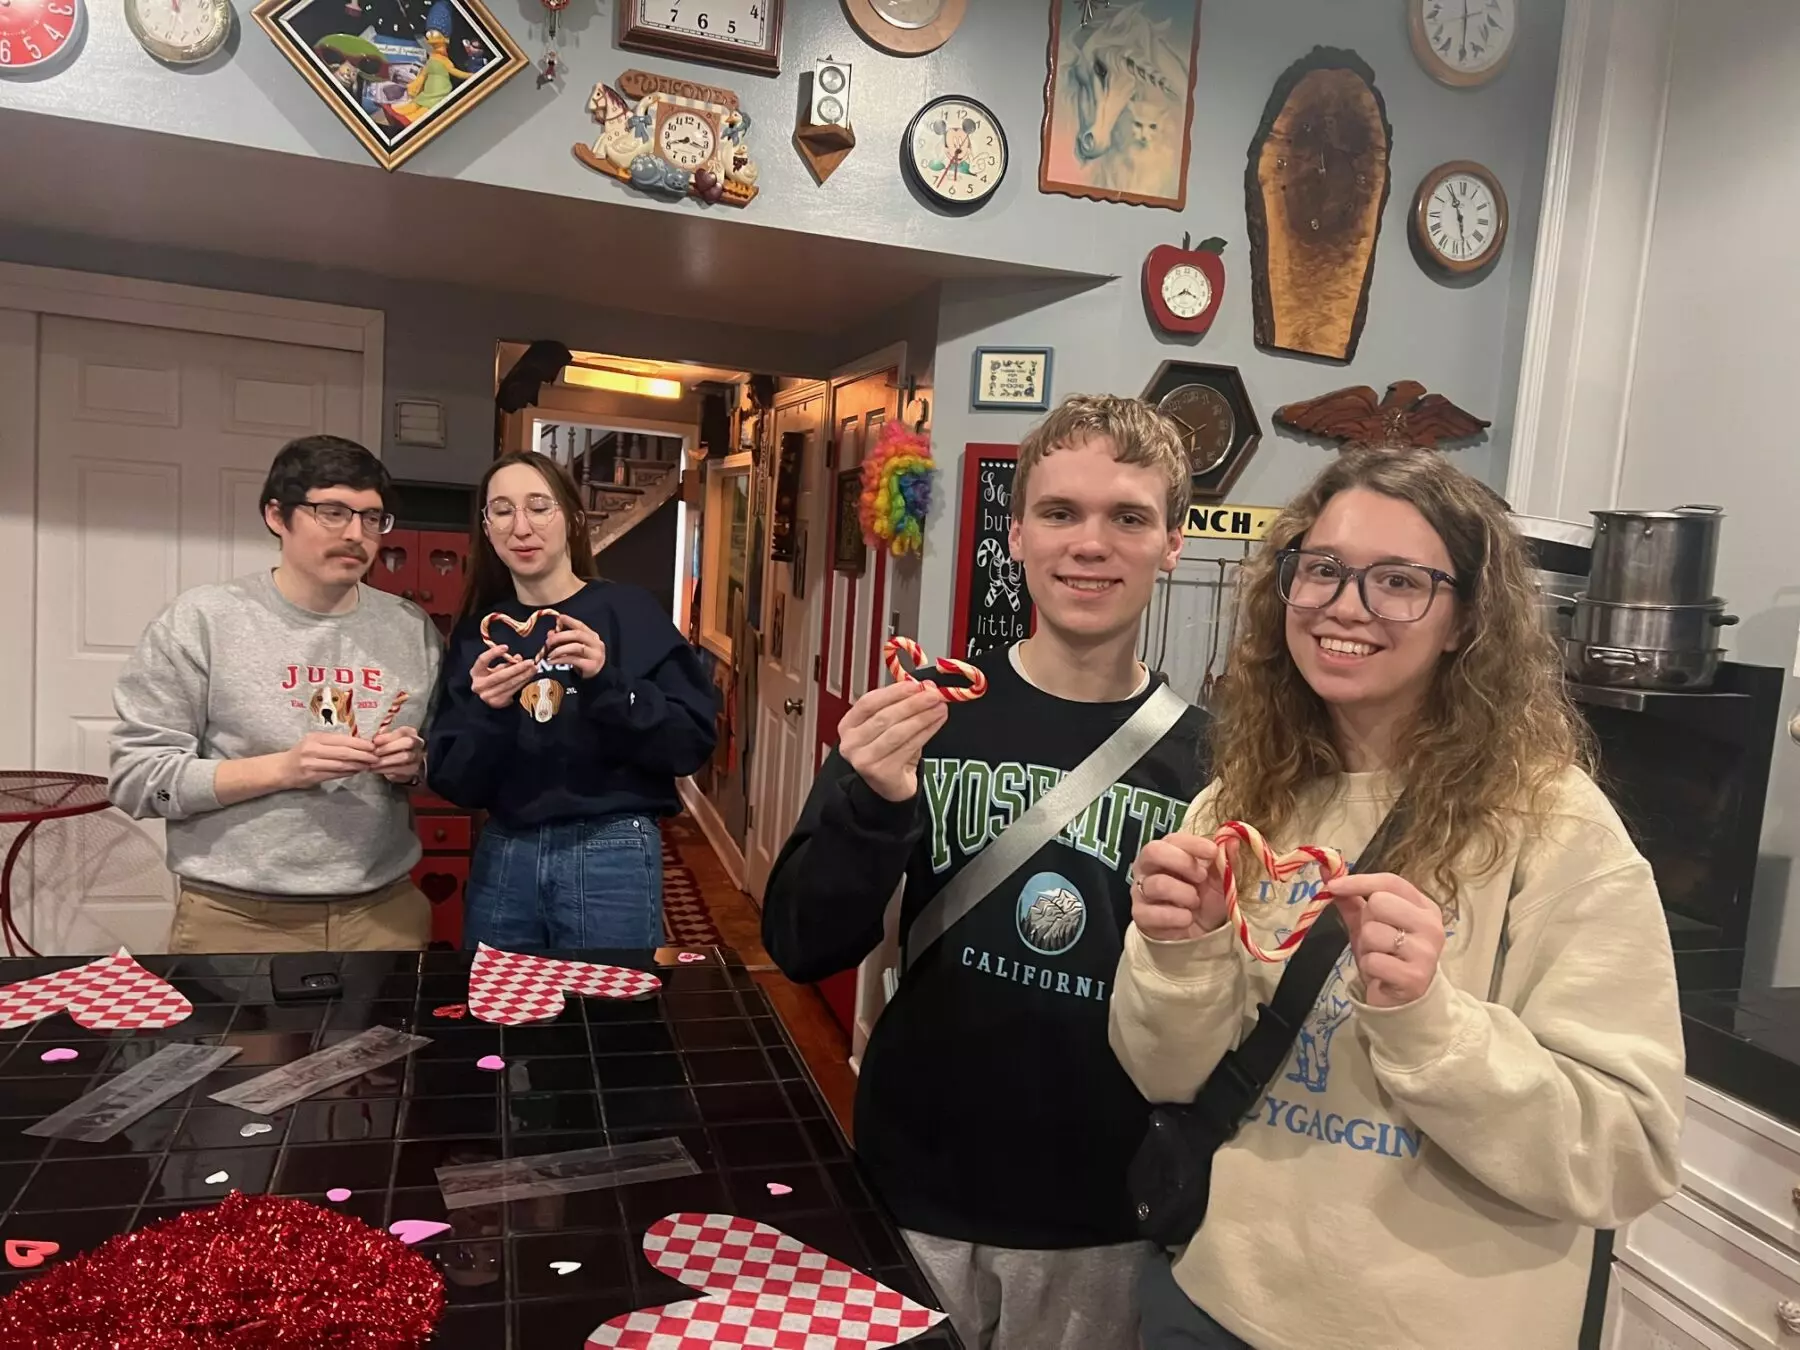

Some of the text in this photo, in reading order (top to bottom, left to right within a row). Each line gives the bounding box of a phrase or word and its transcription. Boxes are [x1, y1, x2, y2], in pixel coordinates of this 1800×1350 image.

[670, 9, 679, 22] 7
[750, 4, 760, 19] 4
[697, 13, 708, 29] 6
[727, 20, 736, 34] 5
[43, 23, 65, 40] 4
[0, 39, 11, 63] 6
[23, 36, 42, 59] 5
[684, 116, 694, 125] 12
[986, 136, 993, 146] 2
[987, 156, 995, 166] 3
[980, 174, 987, 184] 4
[948, 186, 956, 195] 6
[966, 184, 974, 194] 5
[977, 614, 1024, 638] little
[281, 665, 383, 692] JUDE
